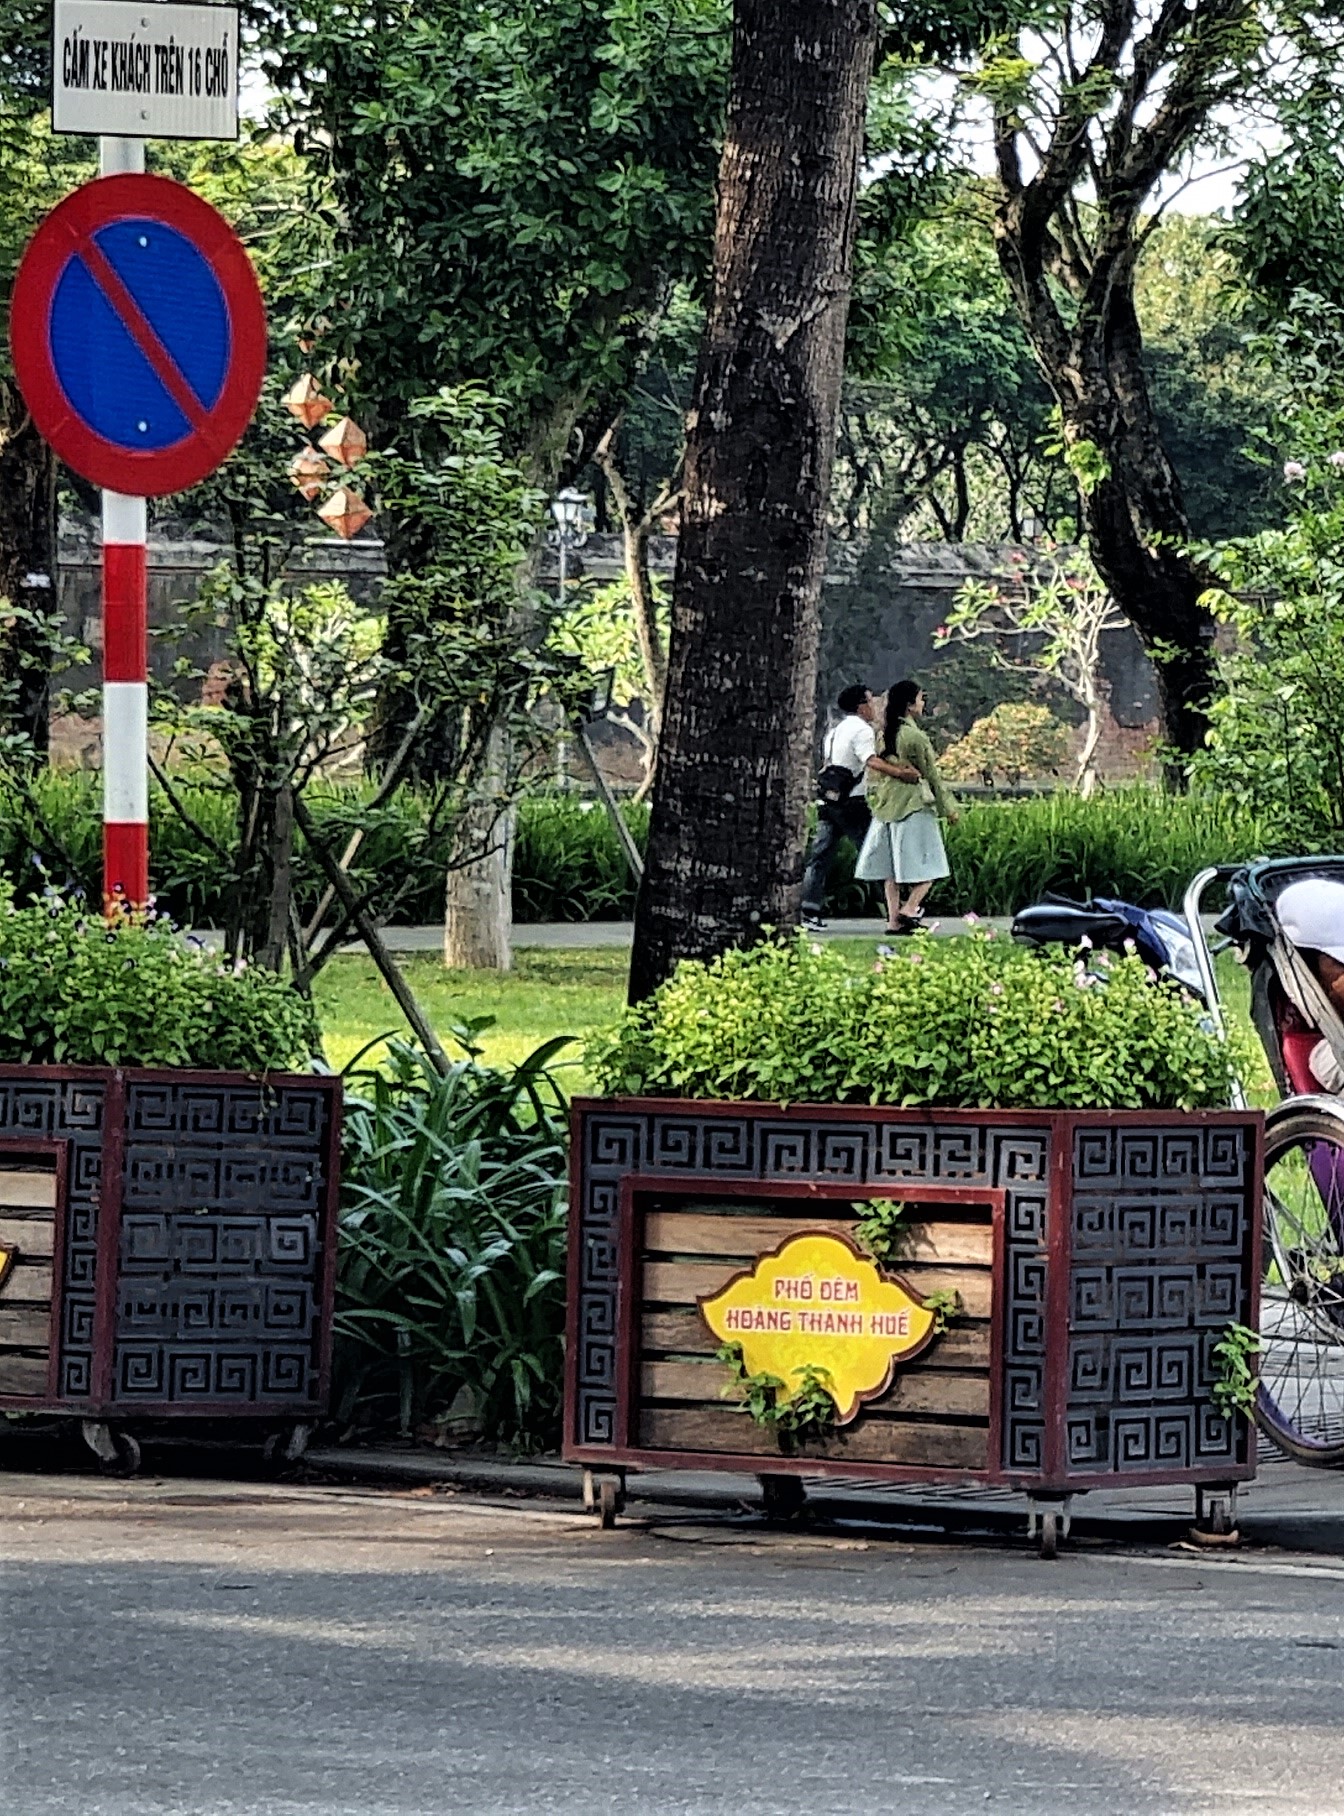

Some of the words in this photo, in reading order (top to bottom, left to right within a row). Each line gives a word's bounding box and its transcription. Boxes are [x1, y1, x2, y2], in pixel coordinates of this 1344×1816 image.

[63, 24, 90, 89] CẤM
[93, 40, 108, 90] XE
[111, 32, 151, 93] KHÁCH
[154, 35, 184, 95] TRÊN
[188, 47, 202, 97] 16
[775, 1274, 816, 1300] PHỐ
[819, 1277, 859, 1302] ĐÊM
[726, 1303, 792, 1331] HOÀNG
[798, 1308, 862, 1334] THÀNH
[870, 1307, 911, 1336] HUẾ
